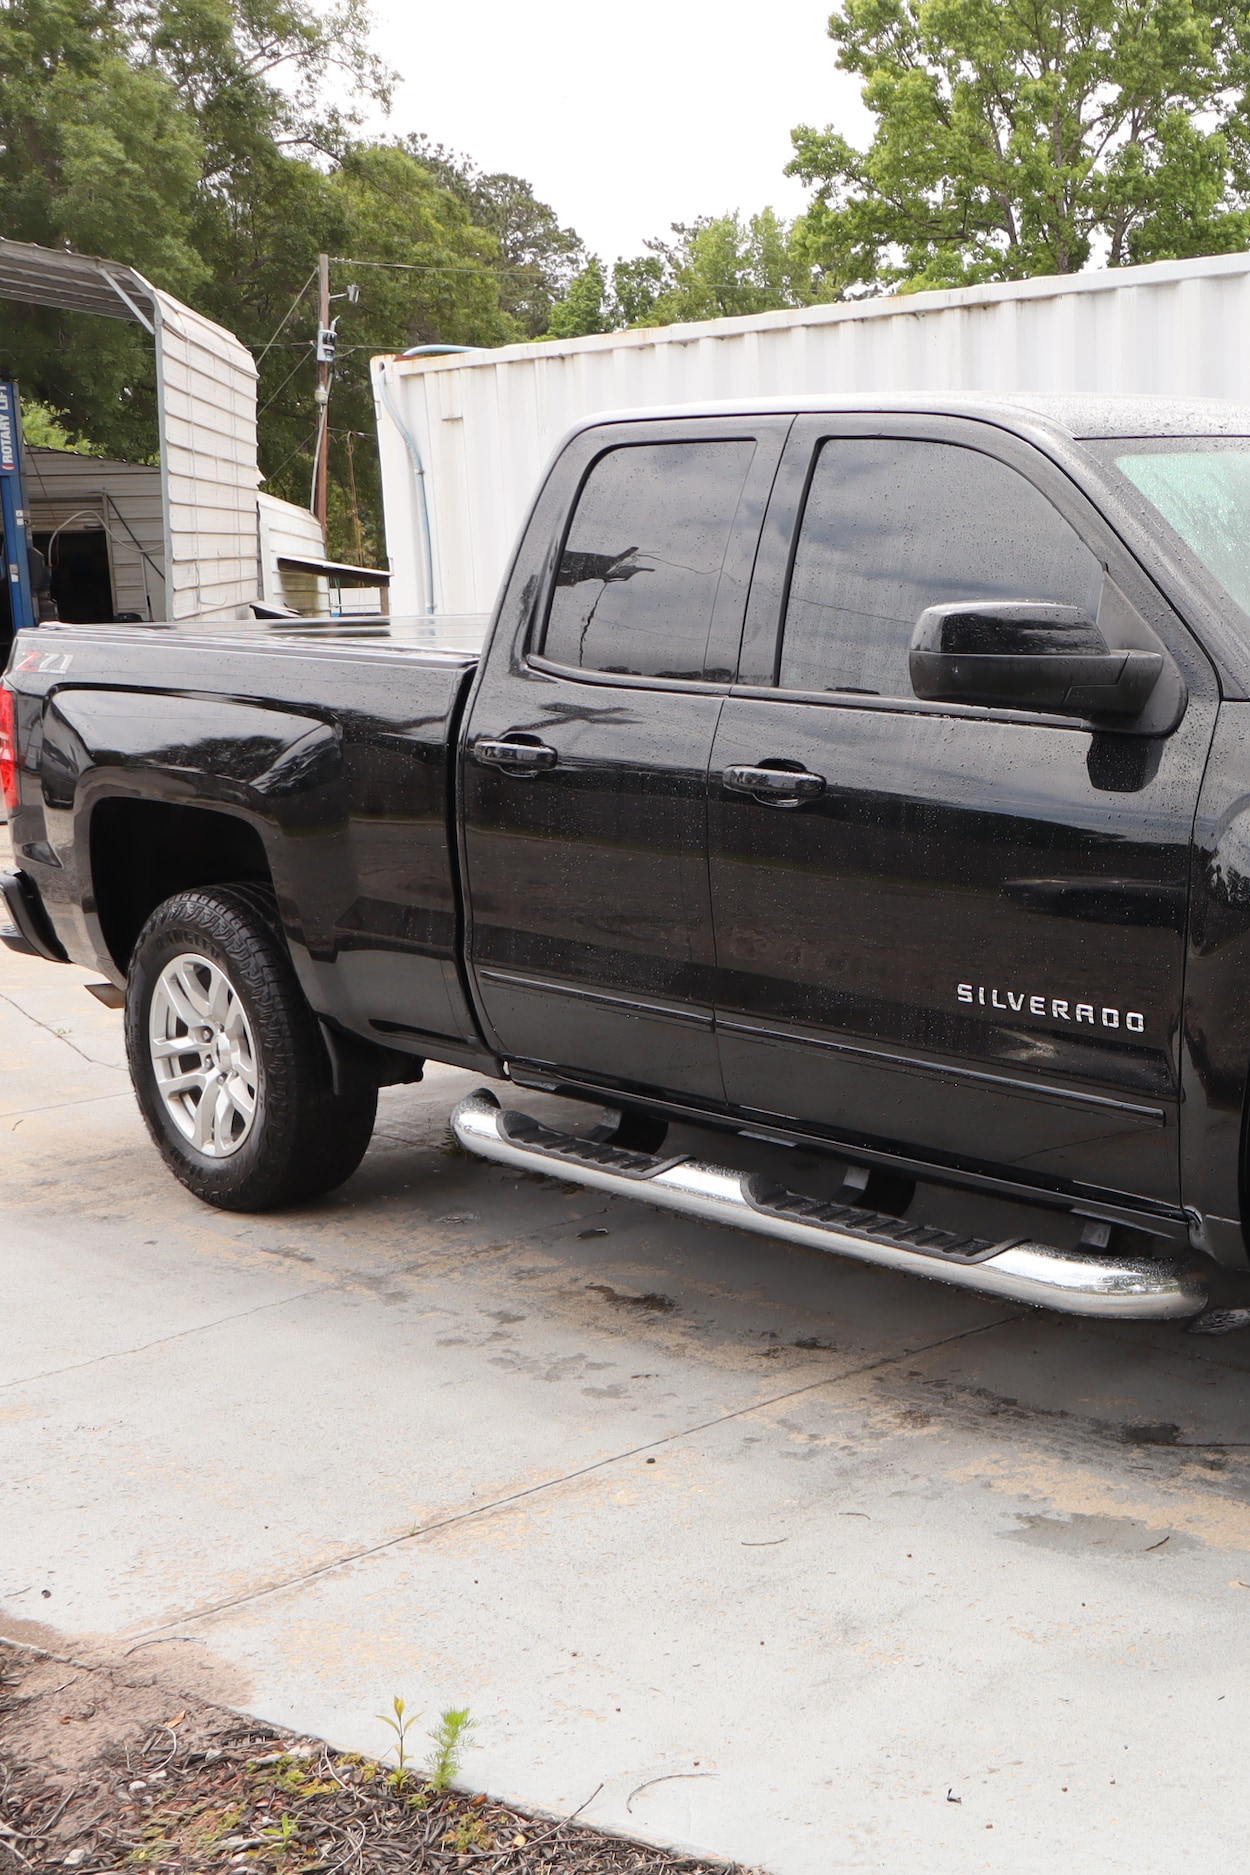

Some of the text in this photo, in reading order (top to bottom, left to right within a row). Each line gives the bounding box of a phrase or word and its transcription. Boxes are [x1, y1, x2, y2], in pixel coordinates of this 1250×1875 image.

[0, 415, 14, 464] ROTARY
[15, 650, 74, 673] Z71
[956, 983, 1146, 1033] SILVERADO
